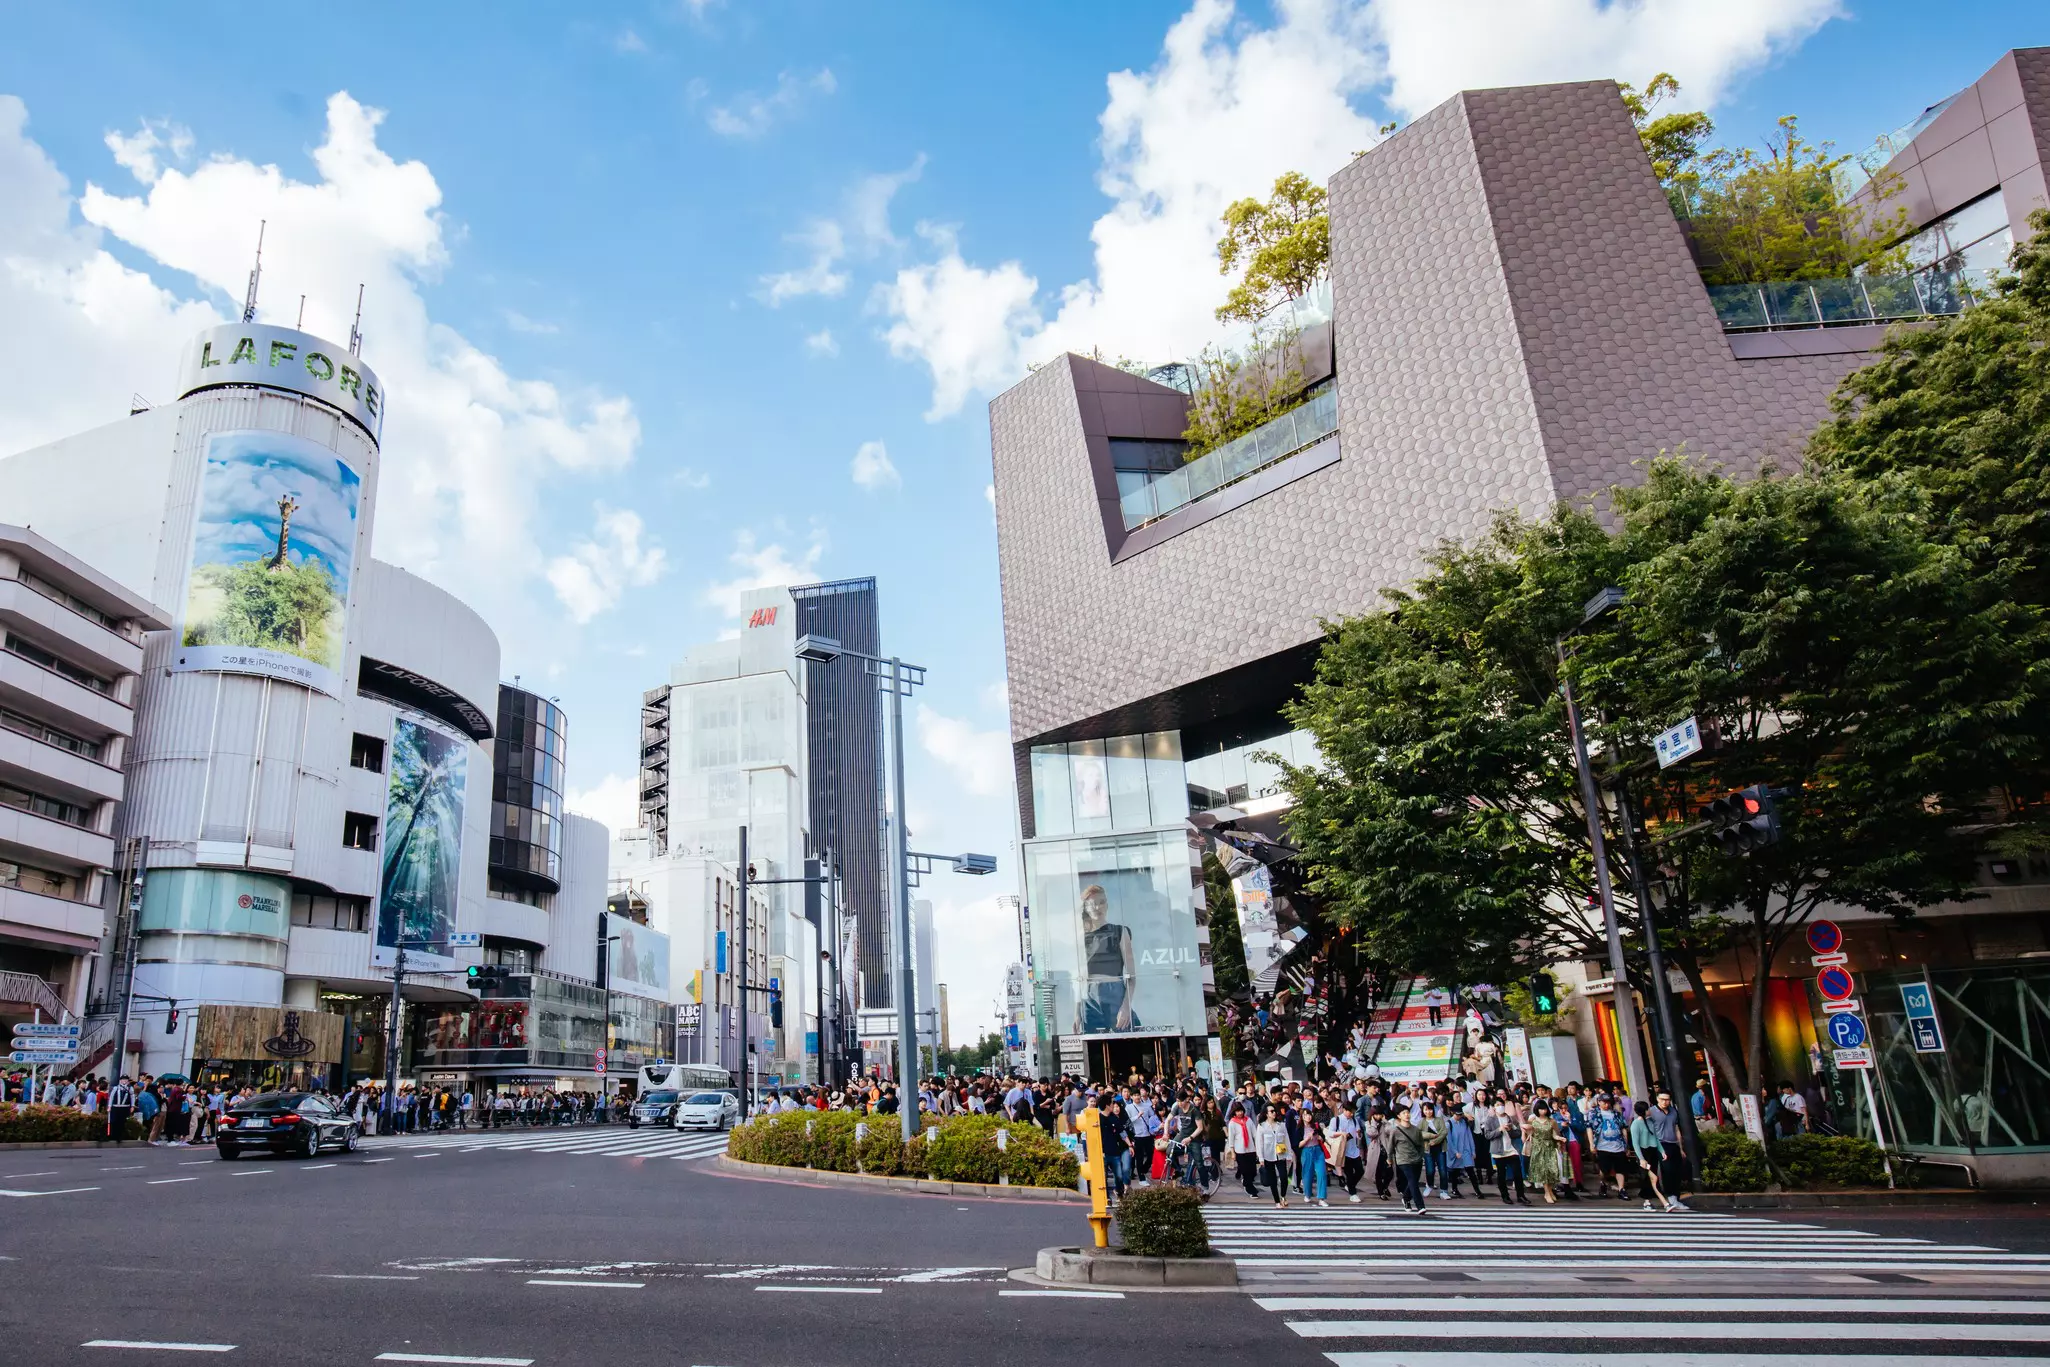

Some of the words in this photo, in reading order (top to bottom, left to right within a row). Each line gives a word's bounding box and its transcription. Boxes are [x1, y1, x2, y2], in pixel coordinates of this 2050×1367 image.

[201, 337, 384, 419] LAFORE
[221, 655, 312, 679] この星をiPhoneで撮影
[374, 664, 456, 698] LAFORET
[1659, 724, 1694, 753] 神宮前
[1140, 947, 1197, 965] AZUL
[678, 1016, 700, 1024] MART
[679, 1006, 700, 1017] ABC
[1835, 1022, 1850, 1044] P
[1848, 1034, 1859, 1044] 60
